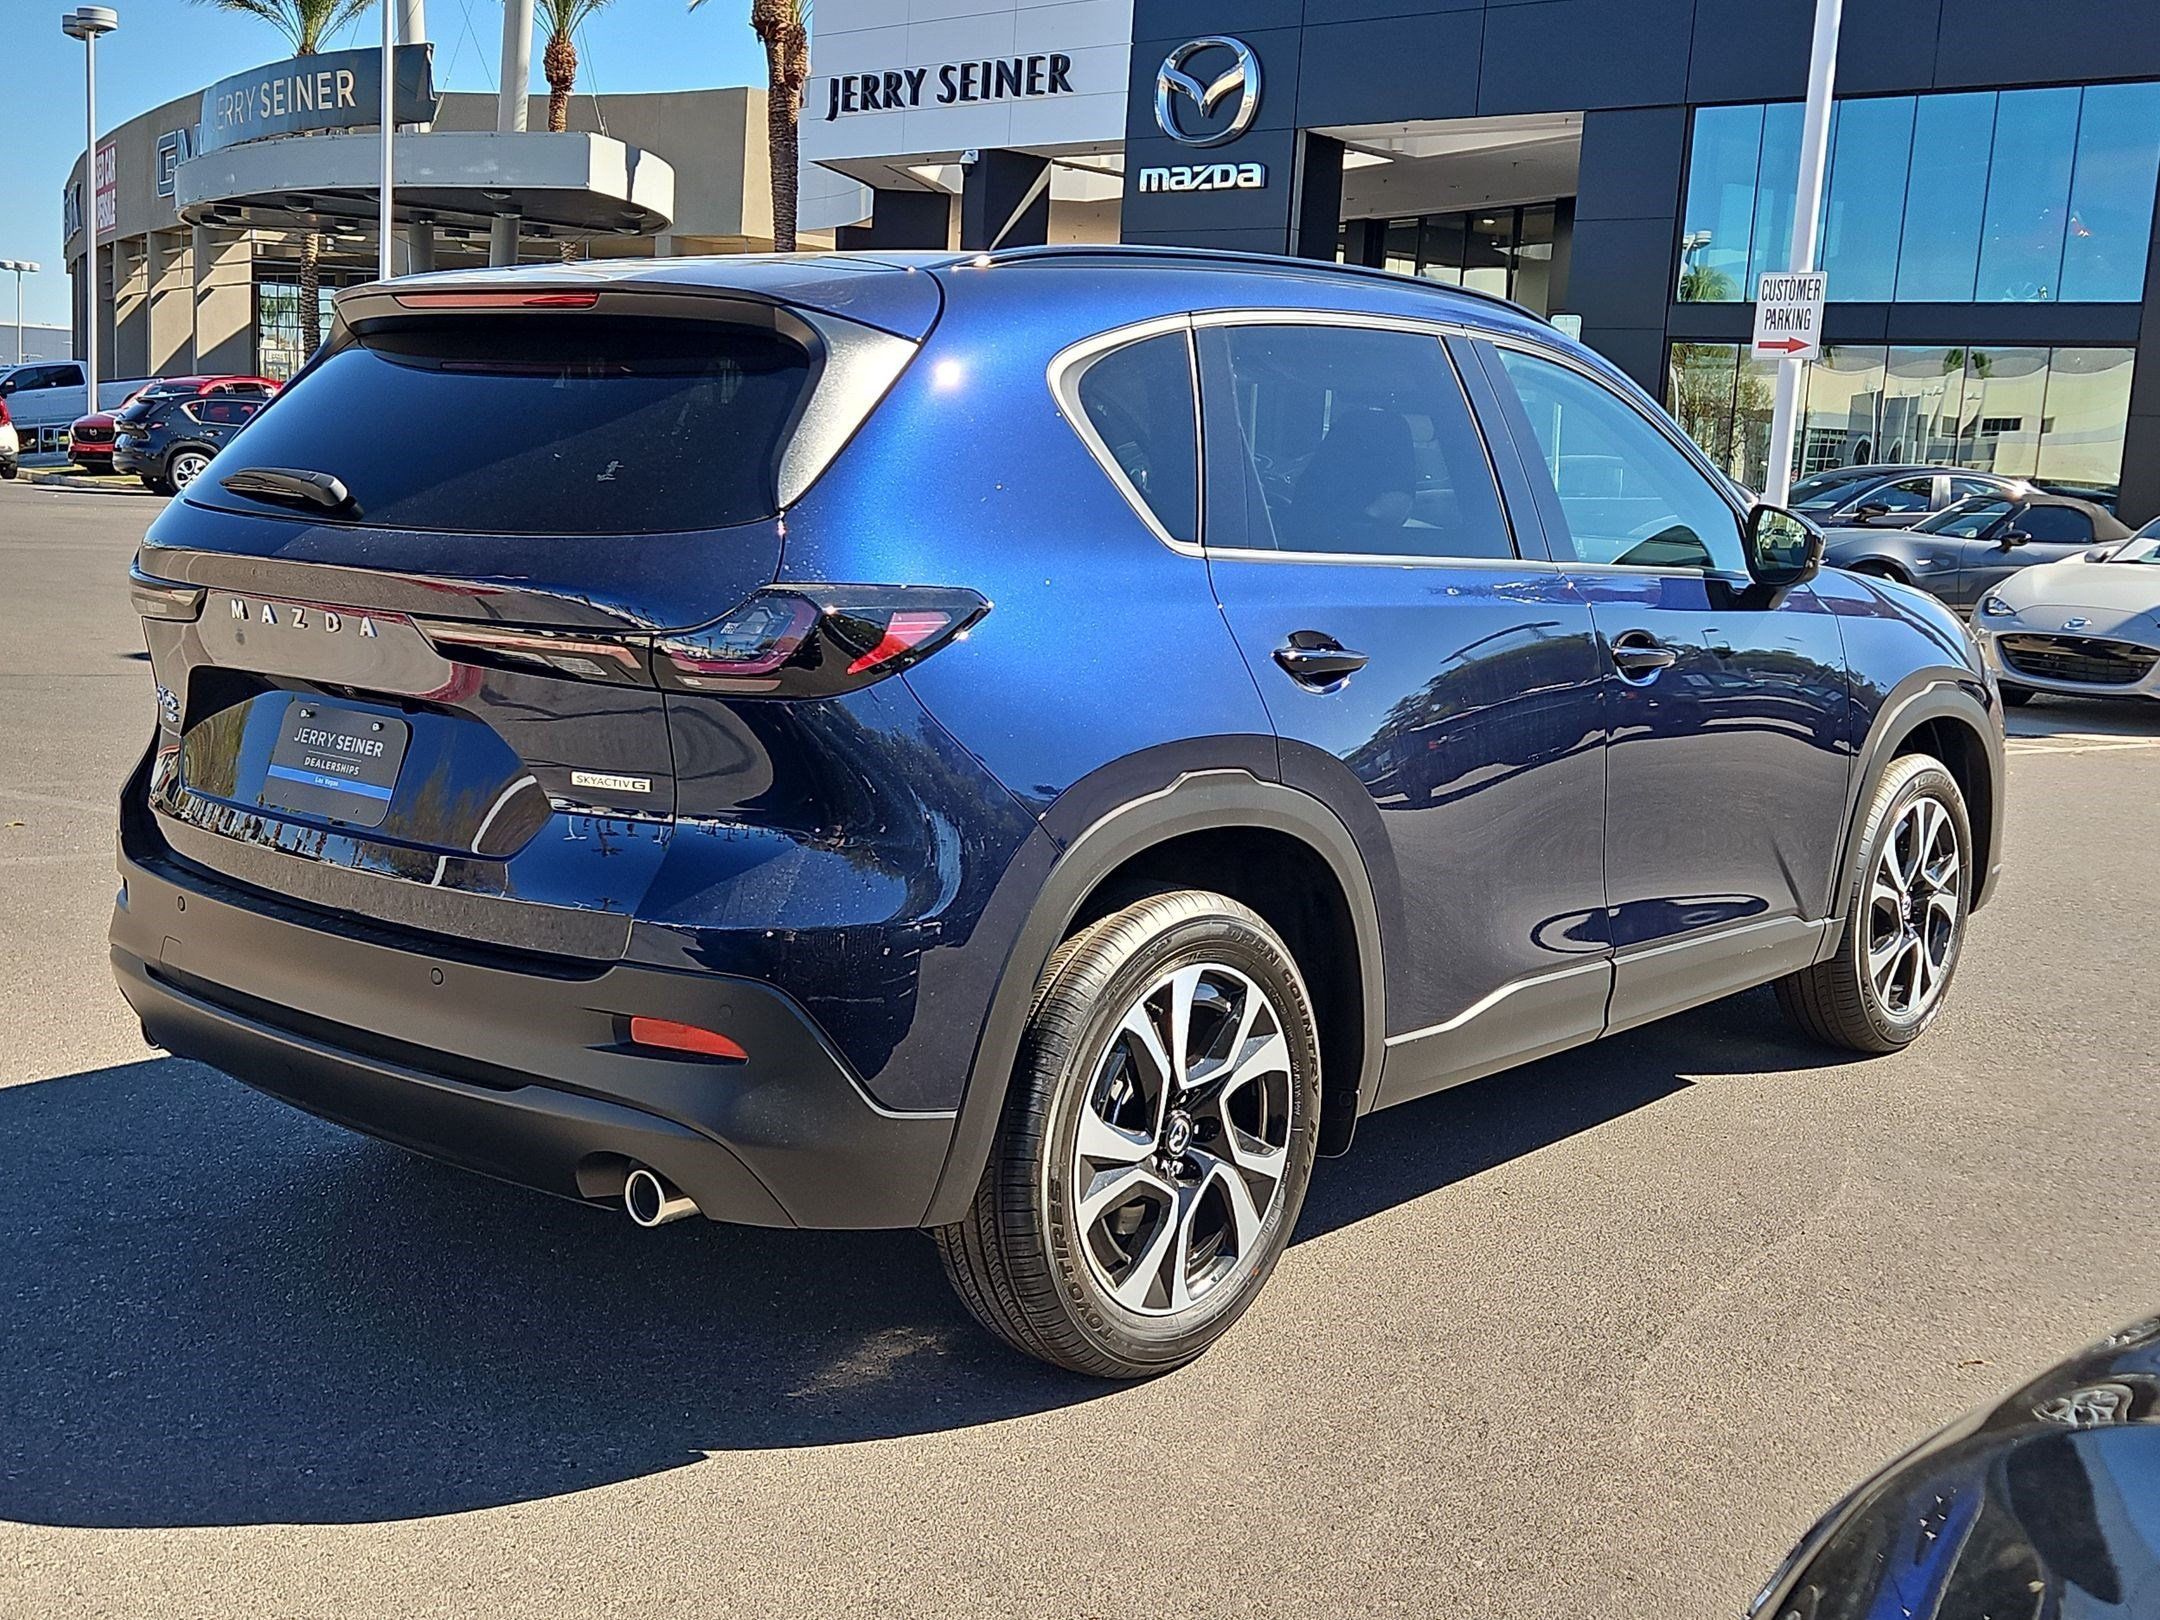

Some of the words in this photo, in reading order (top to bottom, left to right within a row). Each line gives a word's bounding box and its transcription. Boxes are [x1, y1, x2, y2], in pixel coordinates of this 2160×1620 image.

[260, 69, 356, 119] SEINER
[825, 67, 928, 122] JERRY
[936, 53, 1074, 104] SEINER
[1761, 279, 1822, 302] CUSTOMER
[1763, 307, 1812, 331] PARKING
[230, 598, 378, 638] MAZDA
[293, 727, 337, 748] JERRY
[336, 734, 384, 758] SEINER
[303, 756, 360, 776] DEALERSHIPS
[576, 774, 631, 788] SKYACTIV
[632, 780, 646, 791] G
[1282, 967, 1320, 1099] COUNTRY
